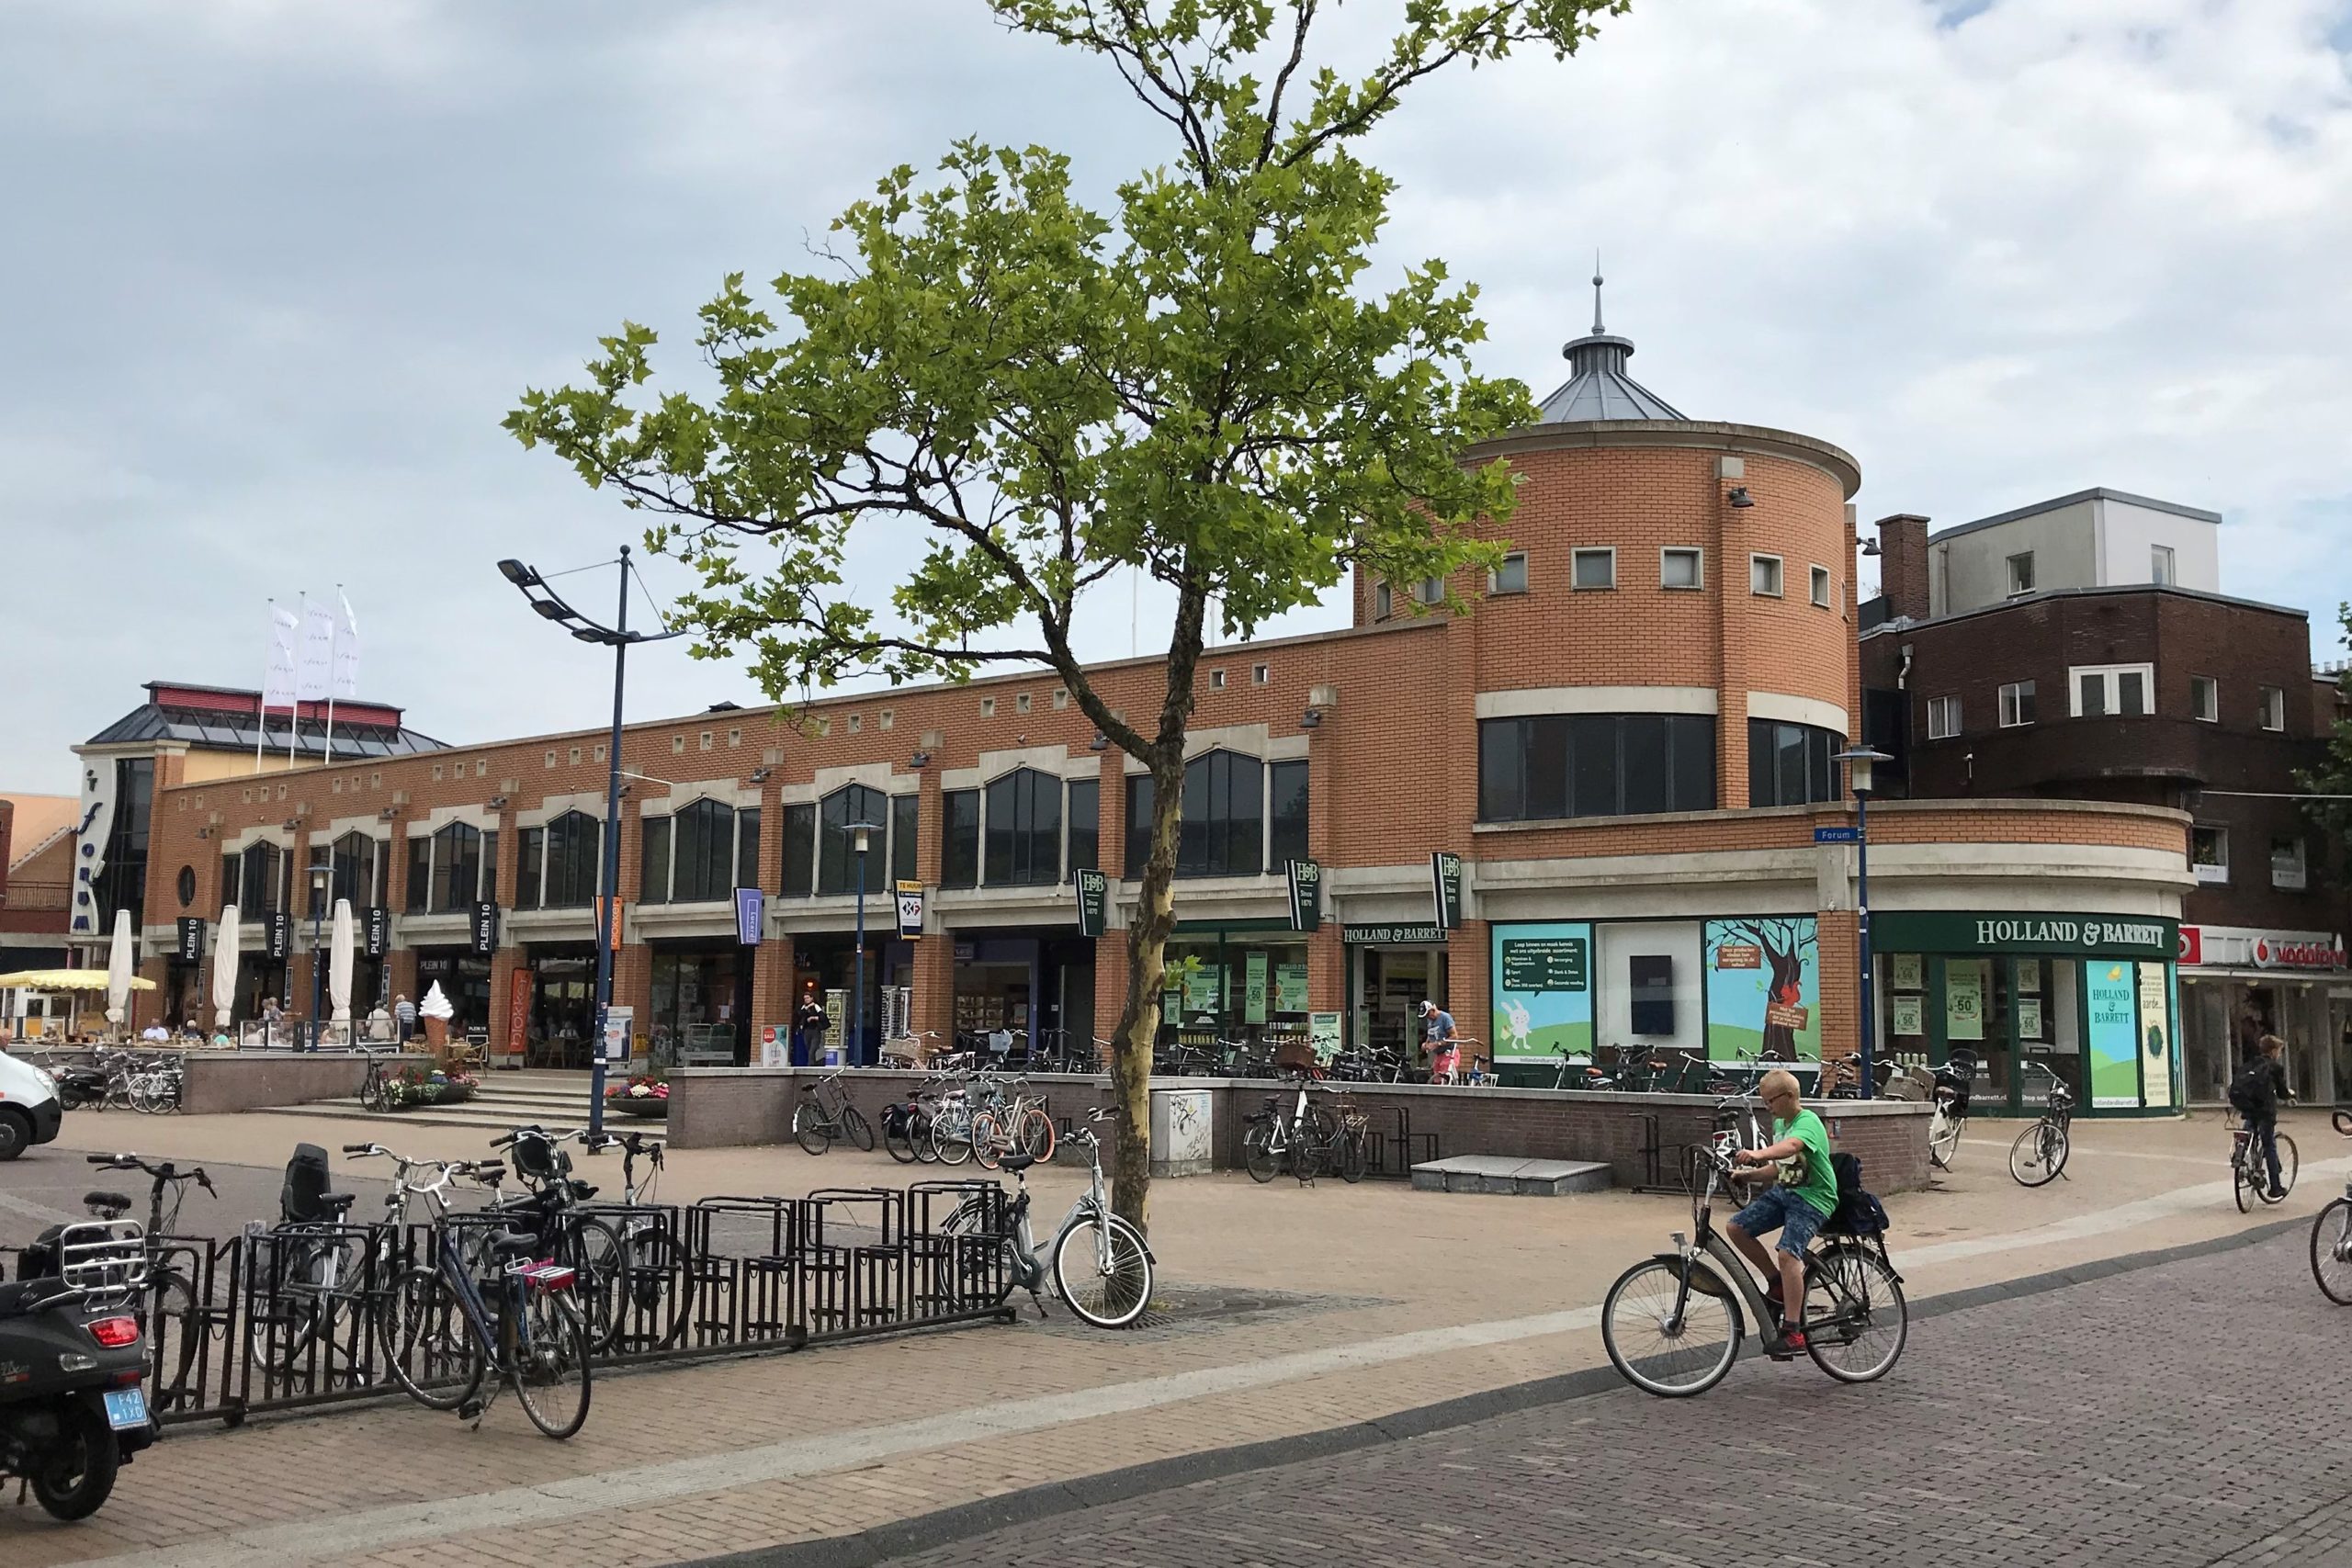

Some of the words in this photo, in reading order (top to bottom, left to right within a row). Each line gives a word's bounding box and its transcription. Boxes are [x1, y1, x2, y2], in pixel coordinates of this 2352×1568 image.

[372, 909, 381, 922] 10
[481, 904, 491, 918] 10
[188, 919, 197, 930] 10
[276, 915, 284, 926] 10
[370, 924, 380, 954] PLEIN
[480, 919, 490, 951] PLEIN
[1344, 929, 1391, 942] HOLLAND
[1392, 928, 1403, 942] &
[1976, 920, 2078, 944] HOLLAND
[2082, 921, 2100, 946] &
[2102, 922, 2165, 948] BARRETT
[187, 932, 197, 959] PLEIN
[274, 929, 284, 957] PLEIN
[420, 960, 439, 970] PLEIN
[2093, 989, 2130, 1000] HOLLAND
[510, 977, 529, 1046] blokker
[2109, 1001, 2116, 1012] &
[2095, 1012, 2130, 1024] BARRETT
